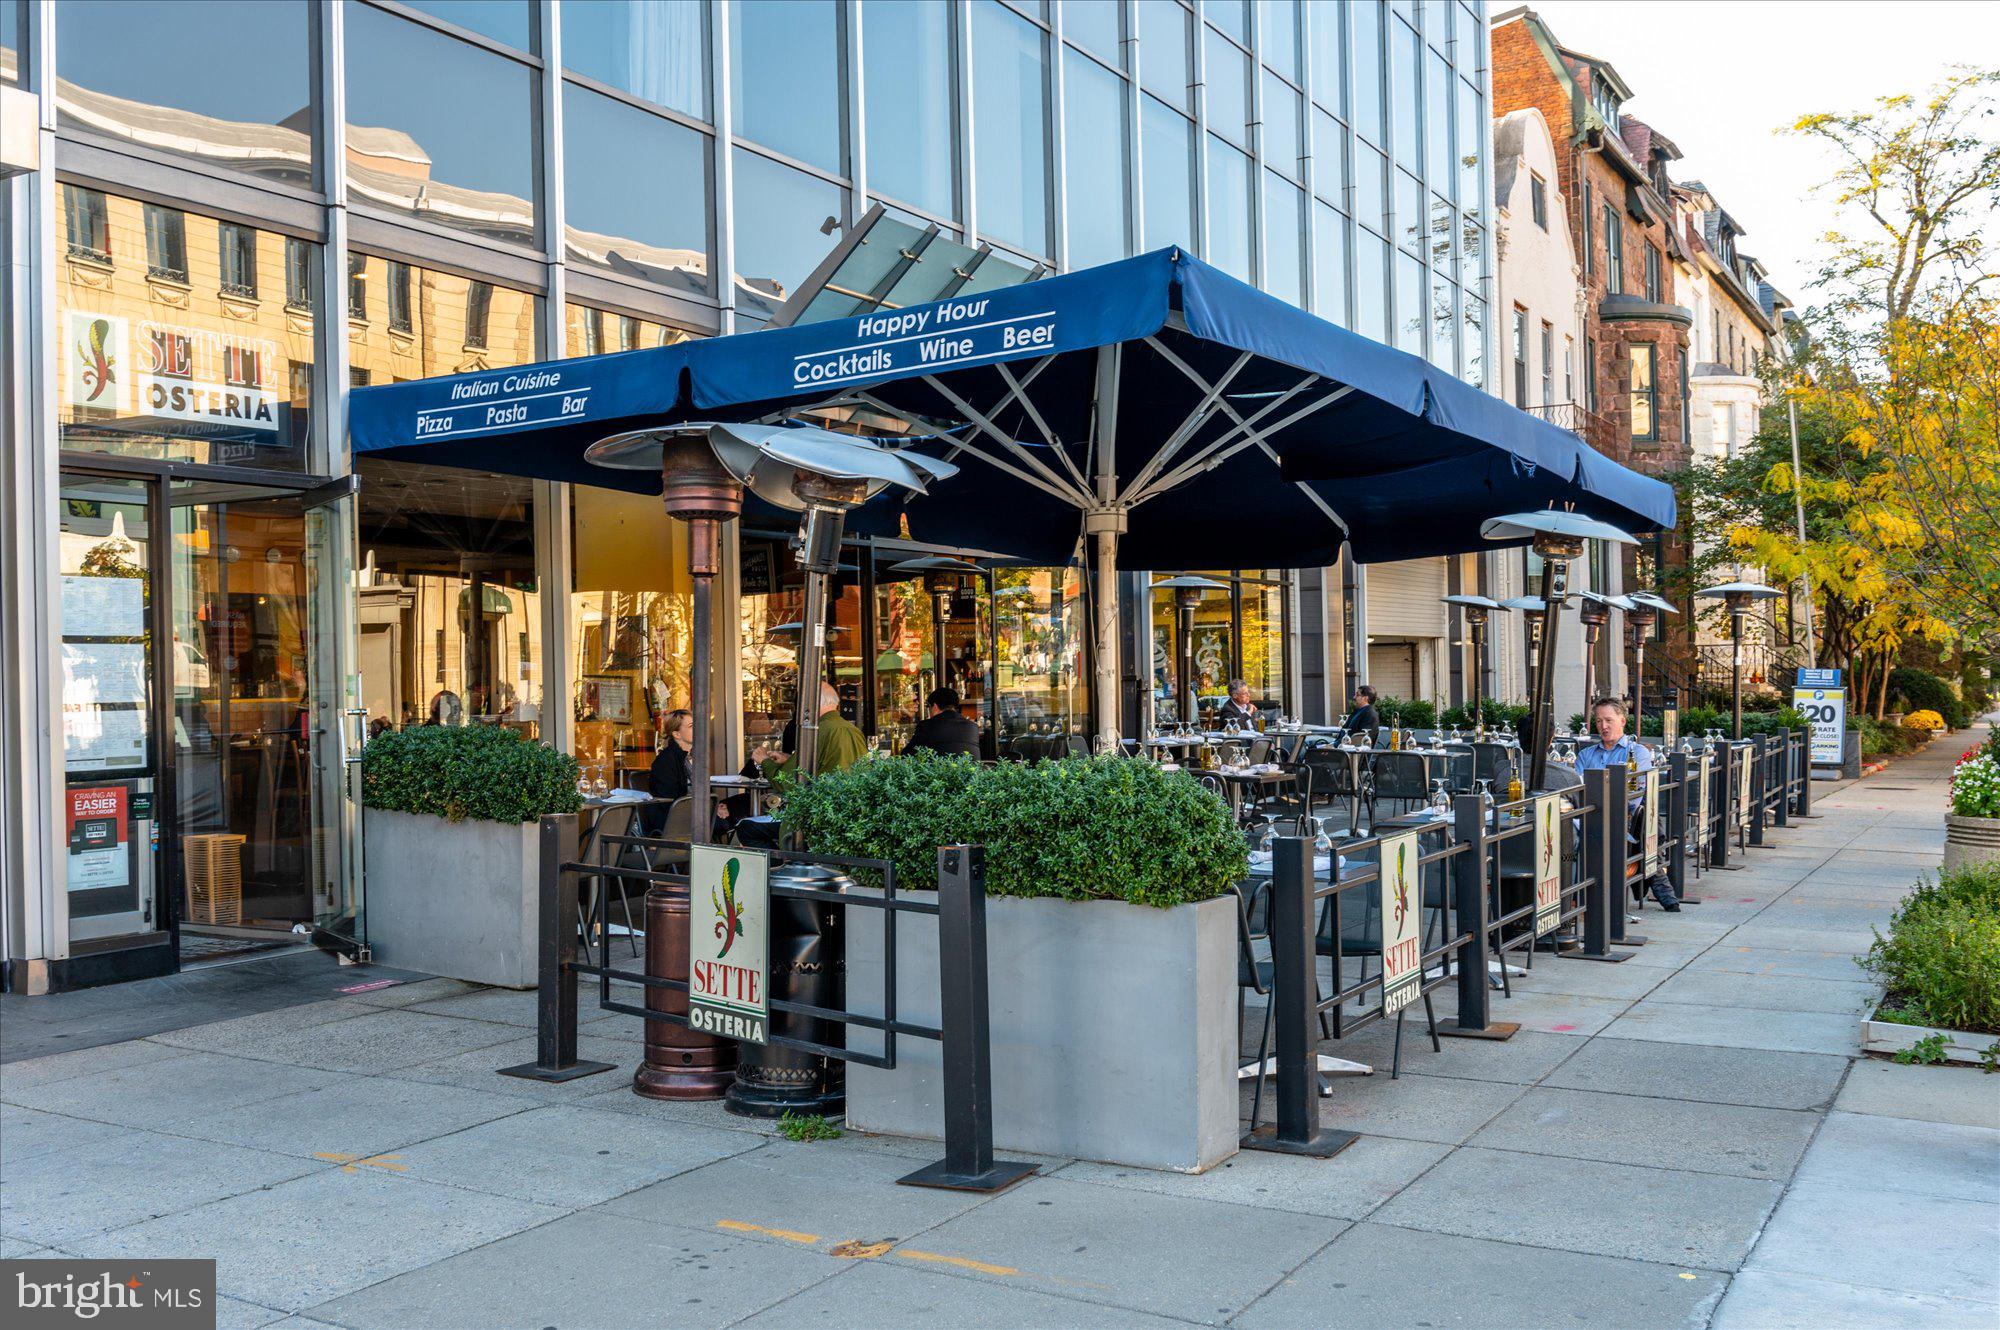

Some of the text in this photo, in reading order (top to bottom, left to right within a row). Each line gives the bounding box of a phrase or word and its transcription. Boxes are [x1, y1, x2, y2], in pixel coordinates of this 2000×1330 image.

[858, 299, 990, 338] Happy Hour
[135, 319, 278, 389] SETTE
[793, 323, 1055, 382] Cocktails Wine Beer
[146, 382, 273, 422] OSTERIA
[451, 371, 561, 400] Italian Cuisine
[416, 396, 588, 434] Pizza Pasta Bar
[1796, 702, 1836, 723] $20
[74, 791, 105, 800] CRAVING
[75, 798, 117, 810] EASIER
[1385, 936, 1418, 980] SETTE
[693, 959, 761, 1005] SETTE
[1386, 981, 1421, 1014] OSTERIA
[690, 1007, 764, 1043] OSTERIA
